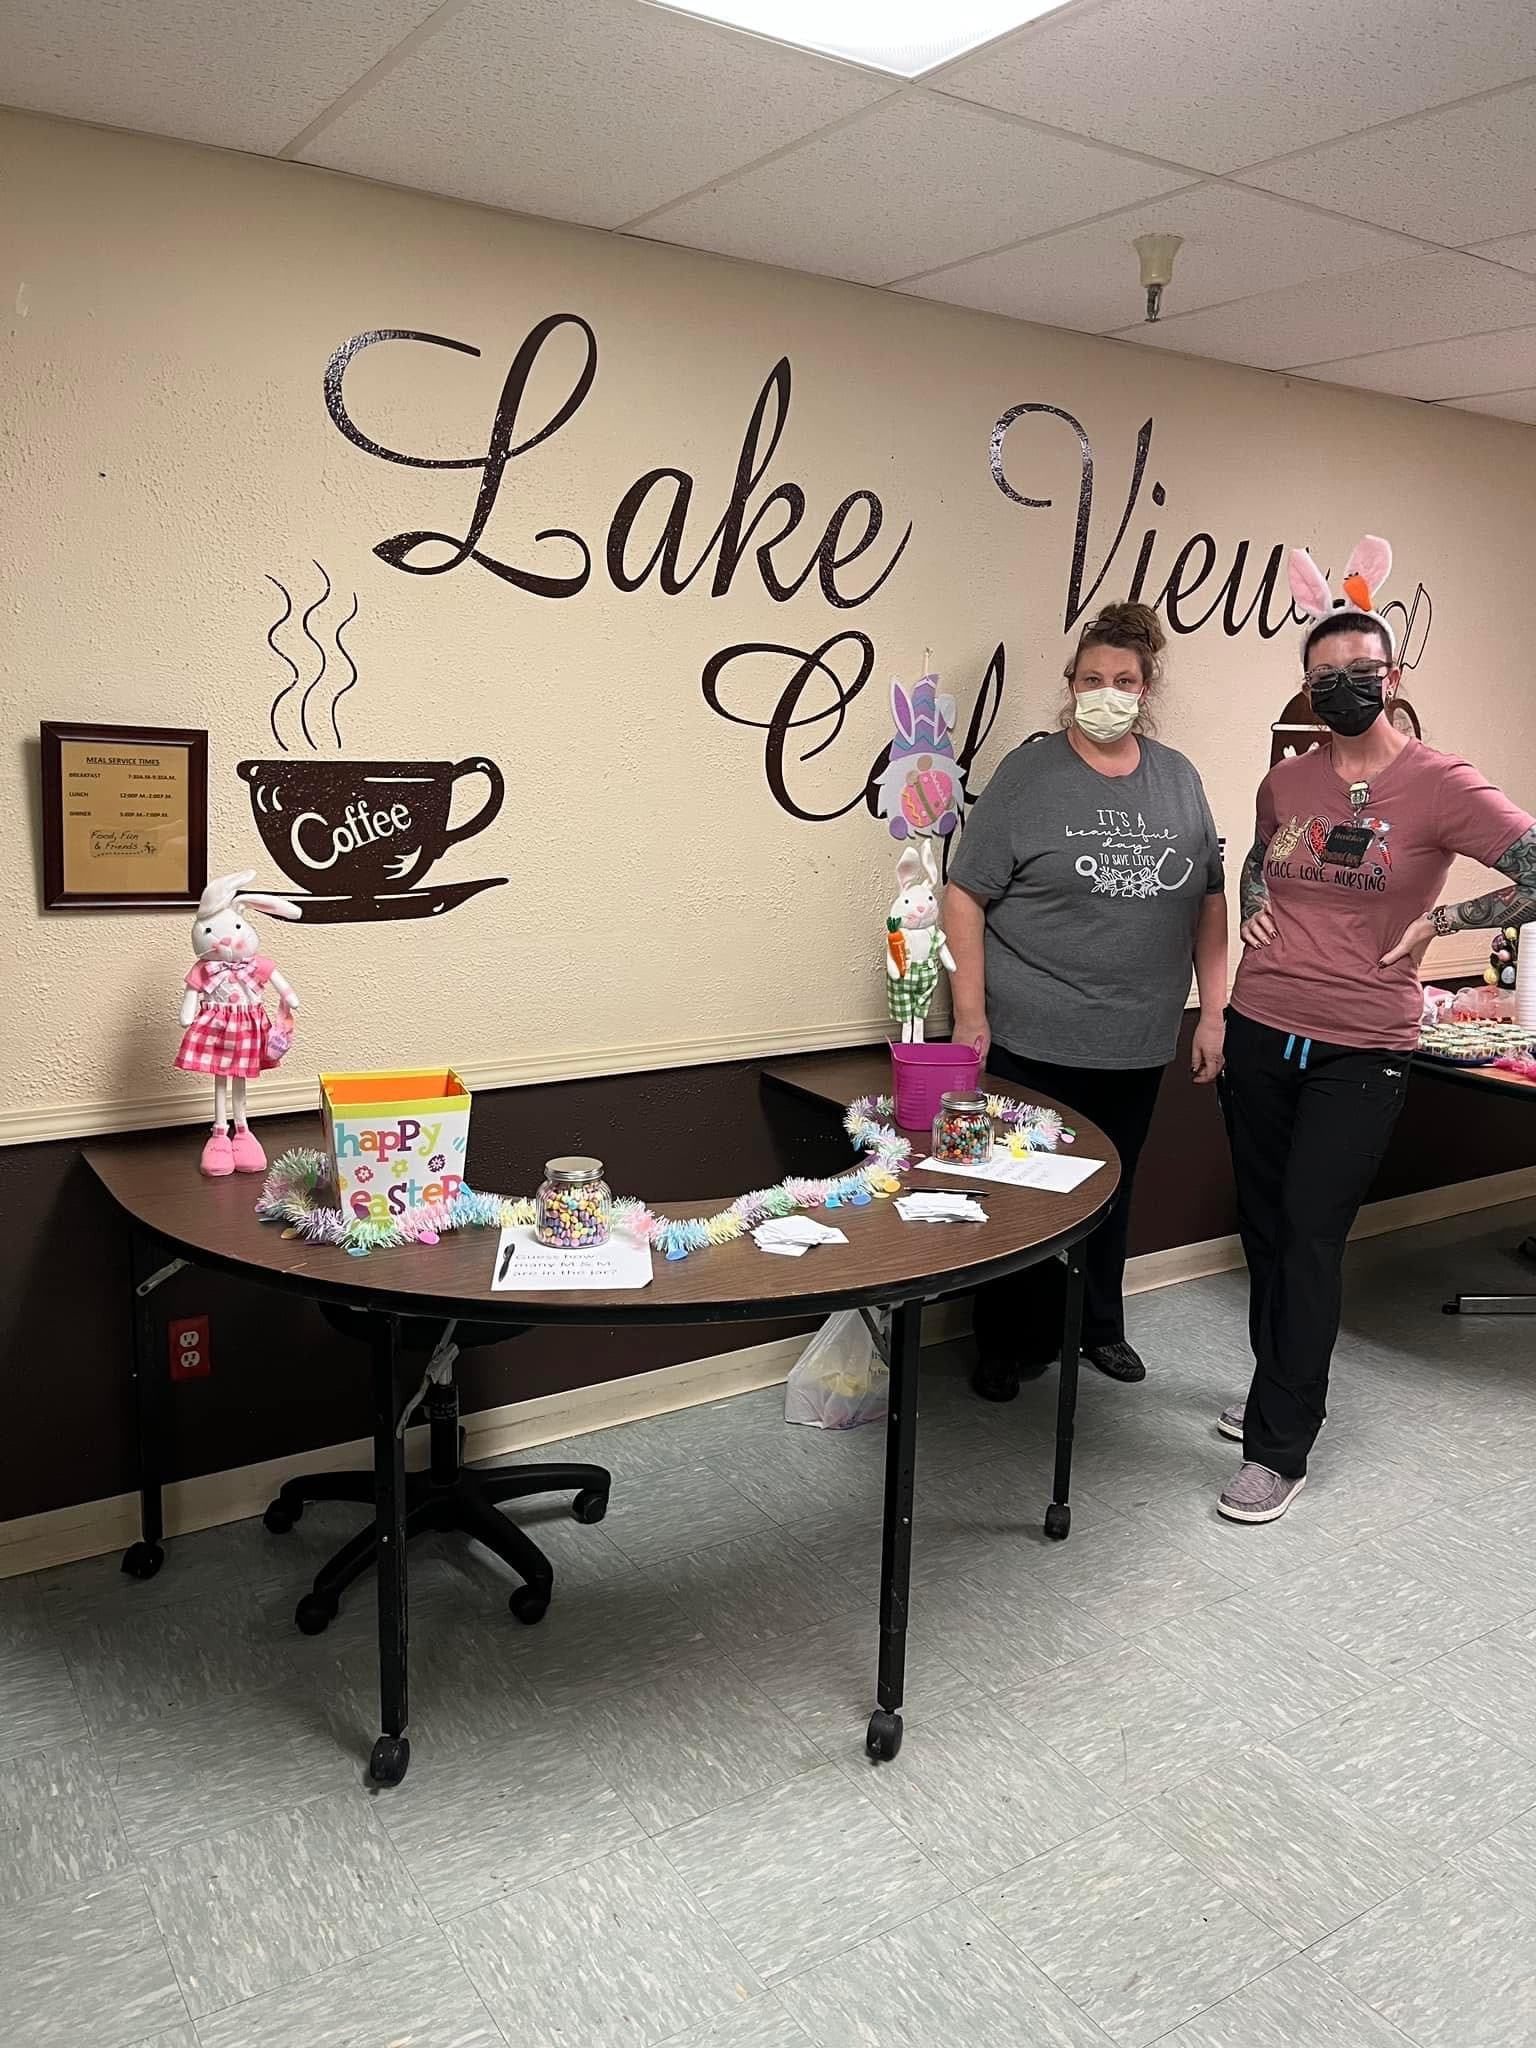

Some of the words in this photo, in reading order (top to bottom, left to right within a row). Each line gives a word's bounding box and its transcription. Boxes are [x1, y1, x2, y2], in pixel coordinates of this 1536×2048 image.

[323, 312, 914, 609] Lake
[86, 756, 107, 765] MEAL
[108, 757, 137, 766] SERVICE
[139, 758, 161, 767] TIMES
[1096, 808, 1131, 828] IT'S
[1137, 812, 1147, 829] A
[90, 830, 117, 843] Food,
[120, 830, 139, 840] Fun
[290, 800, 413, 870] Coffee
[1065, 825, 1178, 842] beautiful
[94, 841, 101, 850] &
[105, 841, 138, 850] Friends
[1102, 837, 1151, 855] day
[1099, 852, 1110, 866] TO
[1112, 853, 1130, 867] SAVE
[1133, 854, 1156, 867] LIVES
[1334, 869, 1386, 892] NURSING
[564, 1252, 596, 1260] how
[514, 1261, 555, 1270] many
[561, 1268, 586, 1276] the
